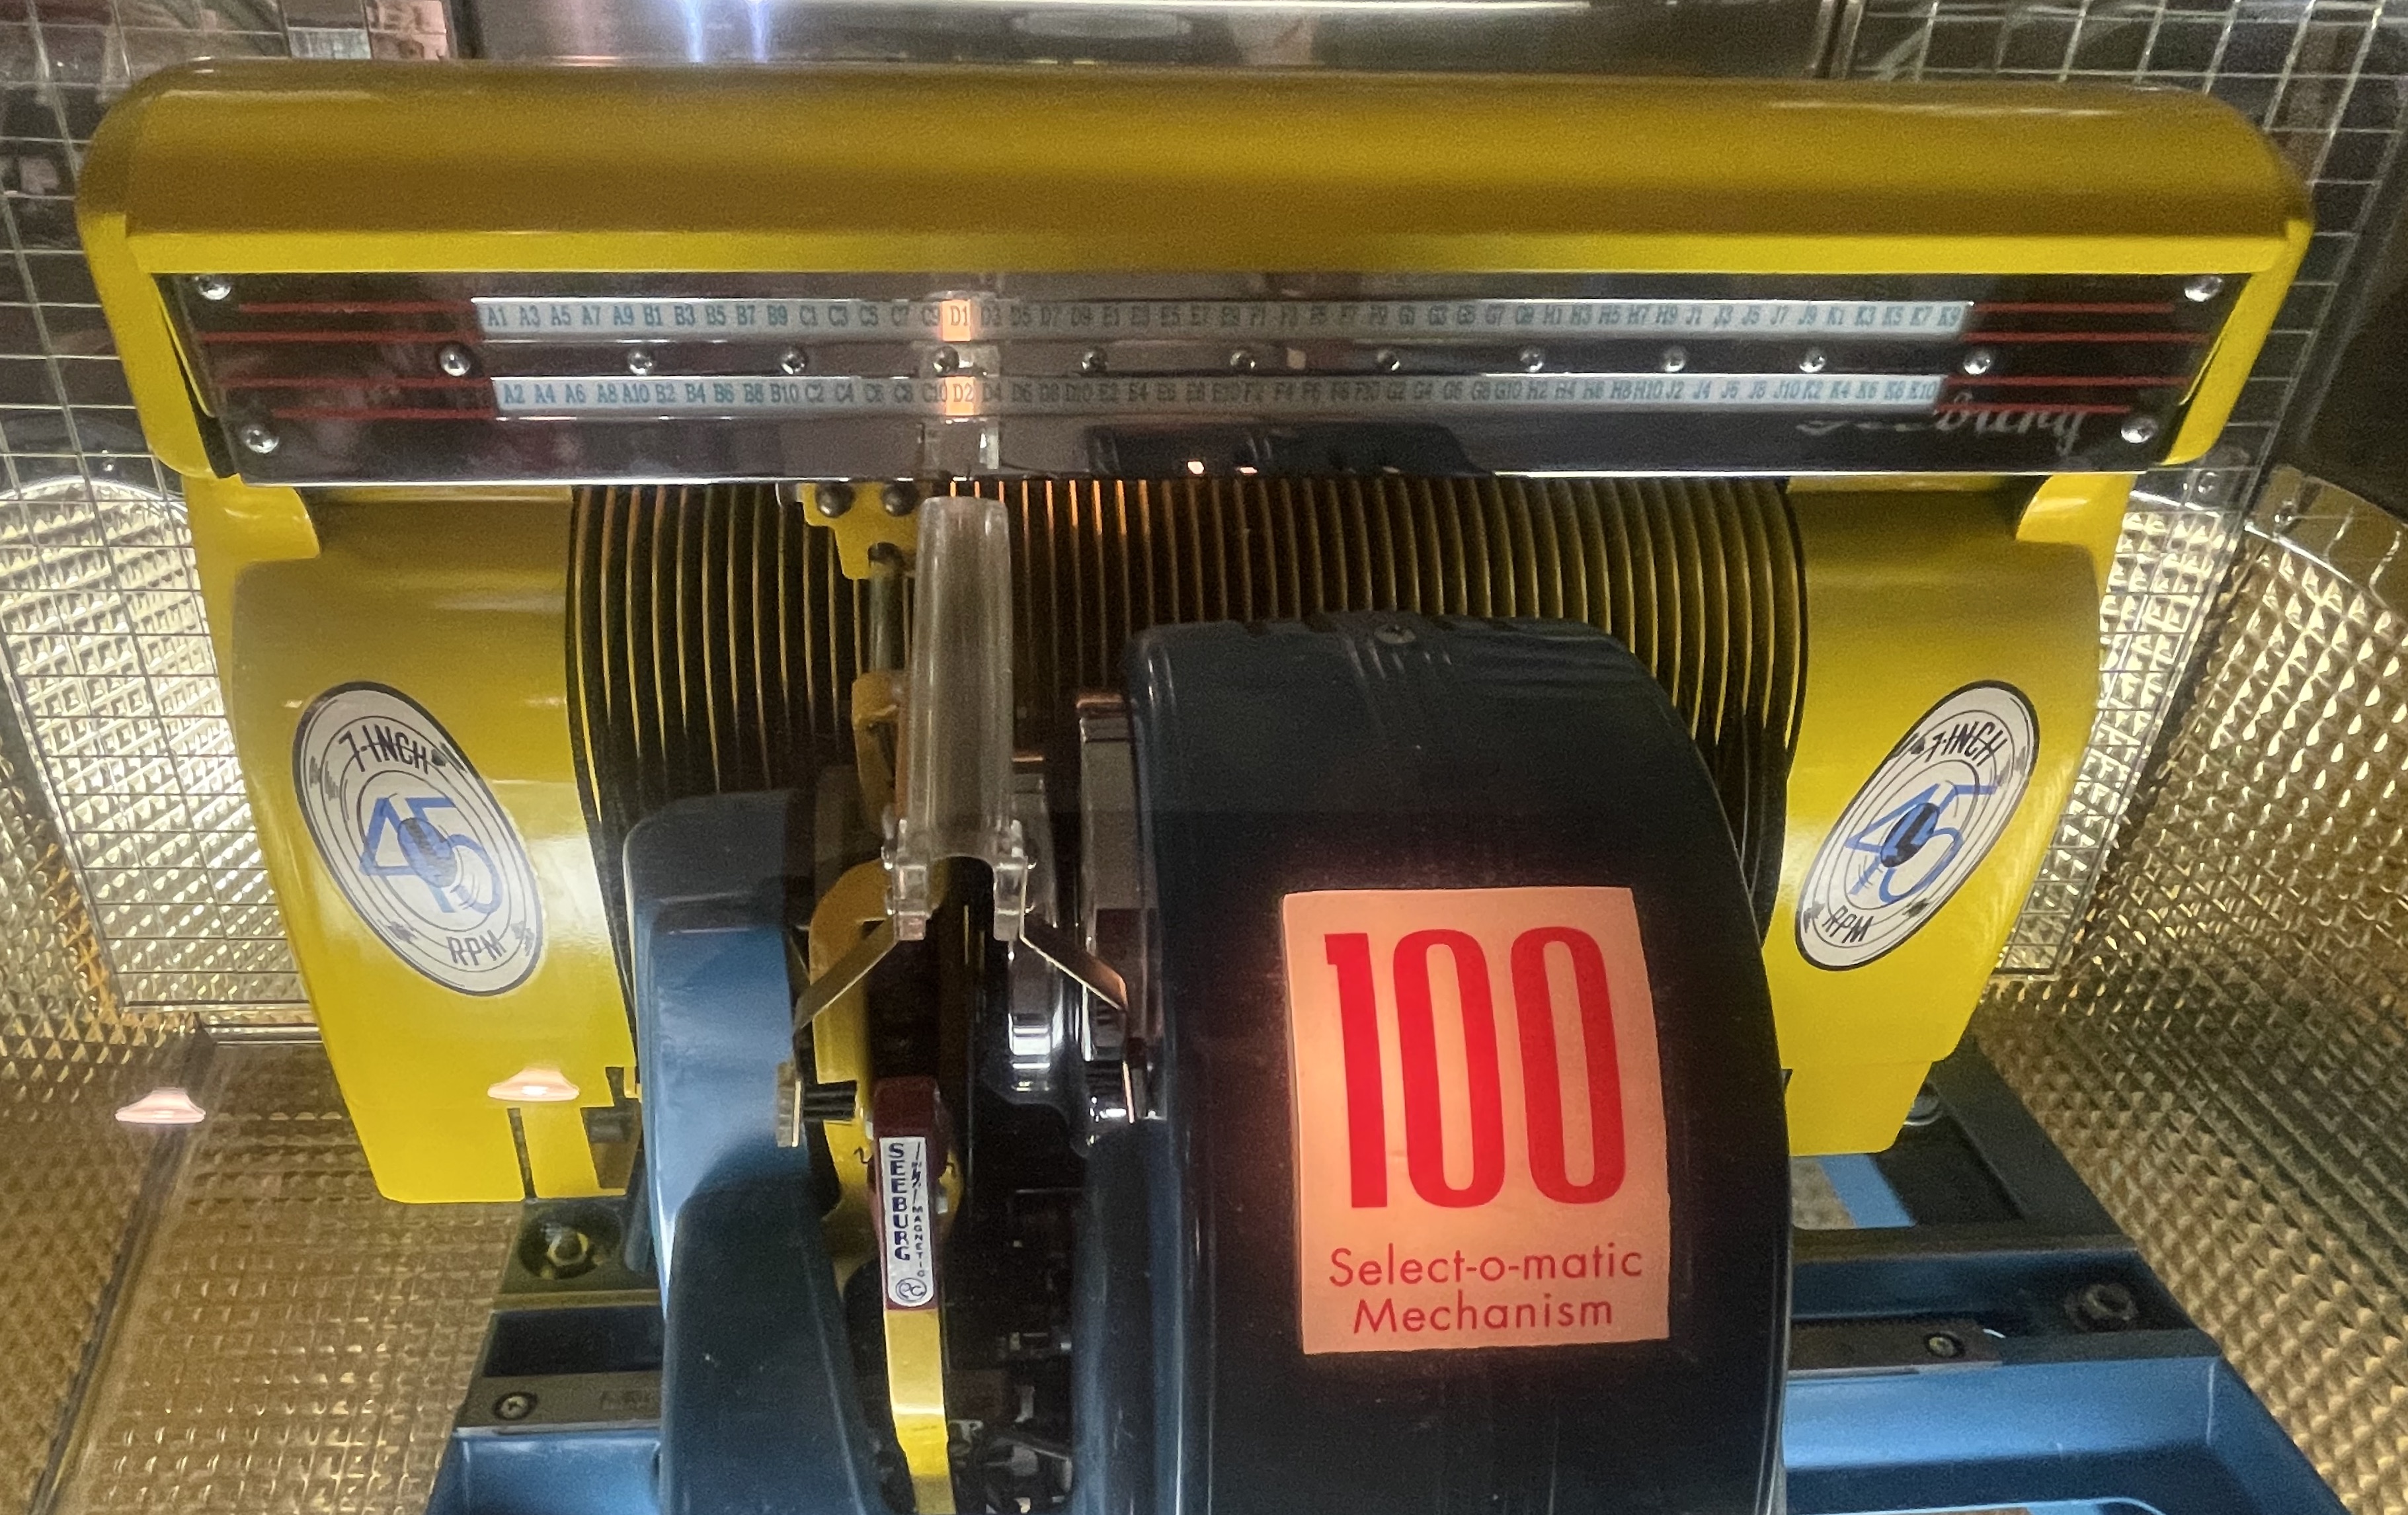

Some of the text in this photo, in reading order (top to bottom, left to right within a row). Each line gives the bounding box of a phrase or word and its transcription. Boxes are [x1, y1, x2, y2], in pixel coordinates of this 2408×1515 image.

[487, 305, 507, 326] A1
[519, 305, 540, 326] A3
[551, 305, 571, 326] A5
[582, 305, 600, 326] A7
[614, 305, 634, 326] A9
[643, 305, 663, 326] B1
[674, 305, 695, 326] B3
[705, 305, 726, 326] B5
[735, 306, 755, 326] B7
[766, 306, 787, 326] B9
[799, 306, 817, 326] C1
[828, 306, 848, 326] C3
[950, 306, 969, 326] D1
[1543, 305, 1562, 325] H1
[1570, 304, 1592, 325] H3
[1598, 304, 1621, 325] H5
[1627, 304, 1650, 325] H7
[1655, 304, 1678, 325] H9
[1686, 305, 1703, 325] J1
[1714, 305, 1734, 325] J3
[1742, 305, 1761, 325] J5
[1770, 306, 1788, 325] J7
[1797, 306, 1818, 326] J9
[1827, 306, 1845, 326] K1
[503, 383, 525, 404] A2
[534, 383, 556, 404] A4
[565, 383, 586, 404] A6
[597, 383, 618, 404] A8
[622, 383, 649, 403] A10
[656, 383, 676, 403] B2
[685, 383, 705, 403] B4
[713, 383, 735, 403] B6
[743, 383, 764, 403] B8
[770, 383, 799, 403] B10
[805, 383, 824, 403] C2
[835, 383, 854, 403] C4
[922, 383, 947, 403] C10
[953, 383, 974, 403] D2
[1611, 380, 1632, 399] H8
[1633, 380, 1664, 399] H10
[1666, 380, 1685, 399] J2
[1693, 380, 1712, 399] J4
[1830, 381, 1852, 399] K4
[359, 797, 503, 914] 45
[1845, 784, 1997, 905] 45
[1822, 905, 1874, 944] RPM
[447, 930, 506, 966] RPM
[1324, 926, 1626, 1208] 100
[889, 1143, 910, 1260] SEEBURG
[1329, 1243, 1642, 1287] Select-o-matic
[1353, 1290, 1613, 1334] Mechanism
